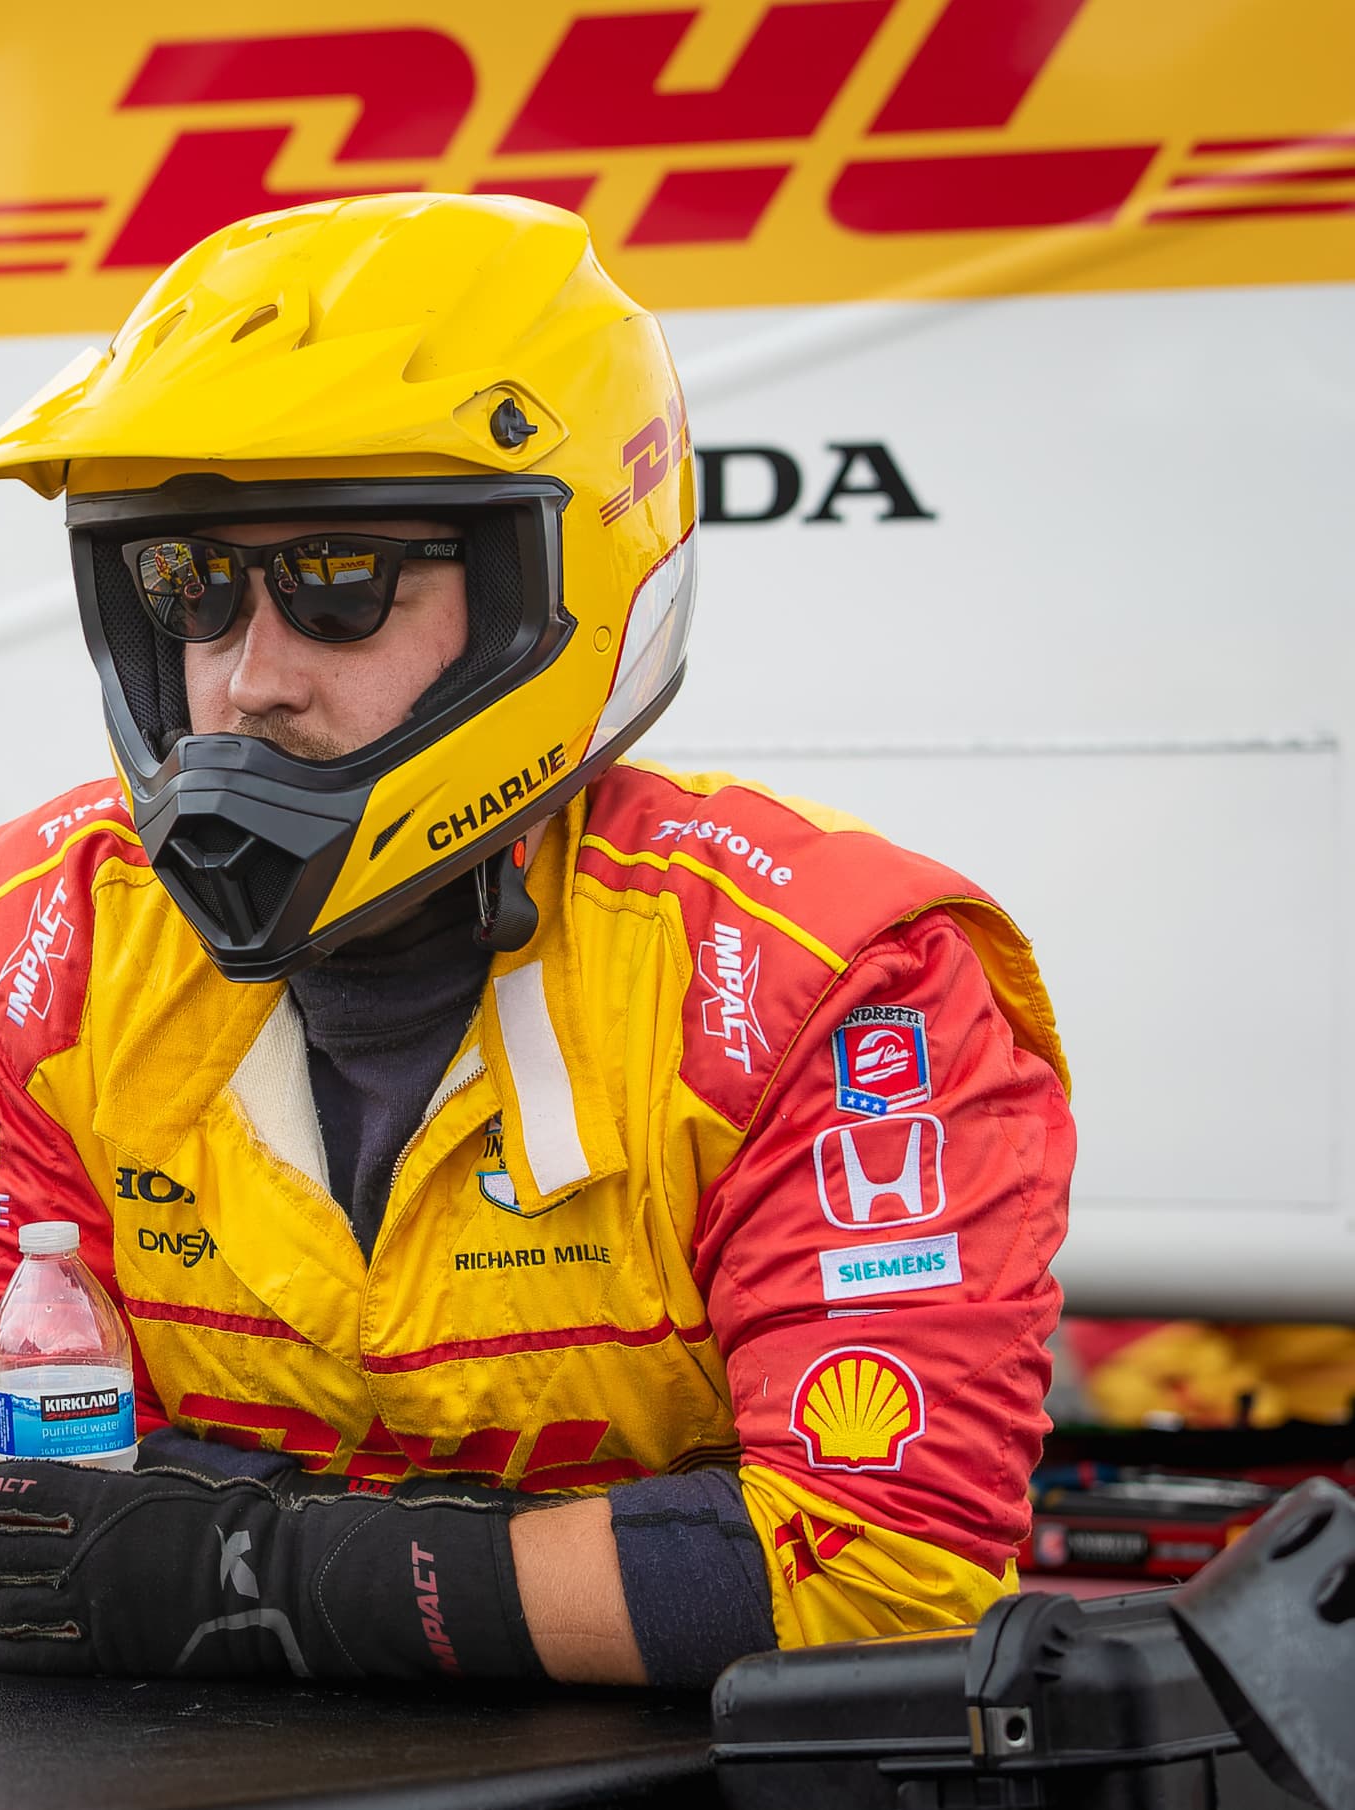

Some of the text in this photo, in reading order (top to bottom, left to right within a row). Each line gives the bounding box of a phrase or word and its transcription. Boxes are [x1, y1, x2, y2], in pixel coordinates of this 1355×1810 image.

[95, 0, 1163, 270] DHL
[427, 742, 567, 852] CHARLIE
[6, 876, 68, 1029] IMPACT
[713, 921, 753, 1075] IMPACT
[844, 1006, 921, 1025] NDRETTI
[455, 1243, 611, 1272] RICHARD MILLE
[838, 1251, 946, 1283] SIEMENS
[41, 1422, 87, 1439] purified
[89, 1420, 120, 1433] water
[45, 1392, 117, 1413] KIRKLAND
[178, 1392, 657, 1494] DHL
